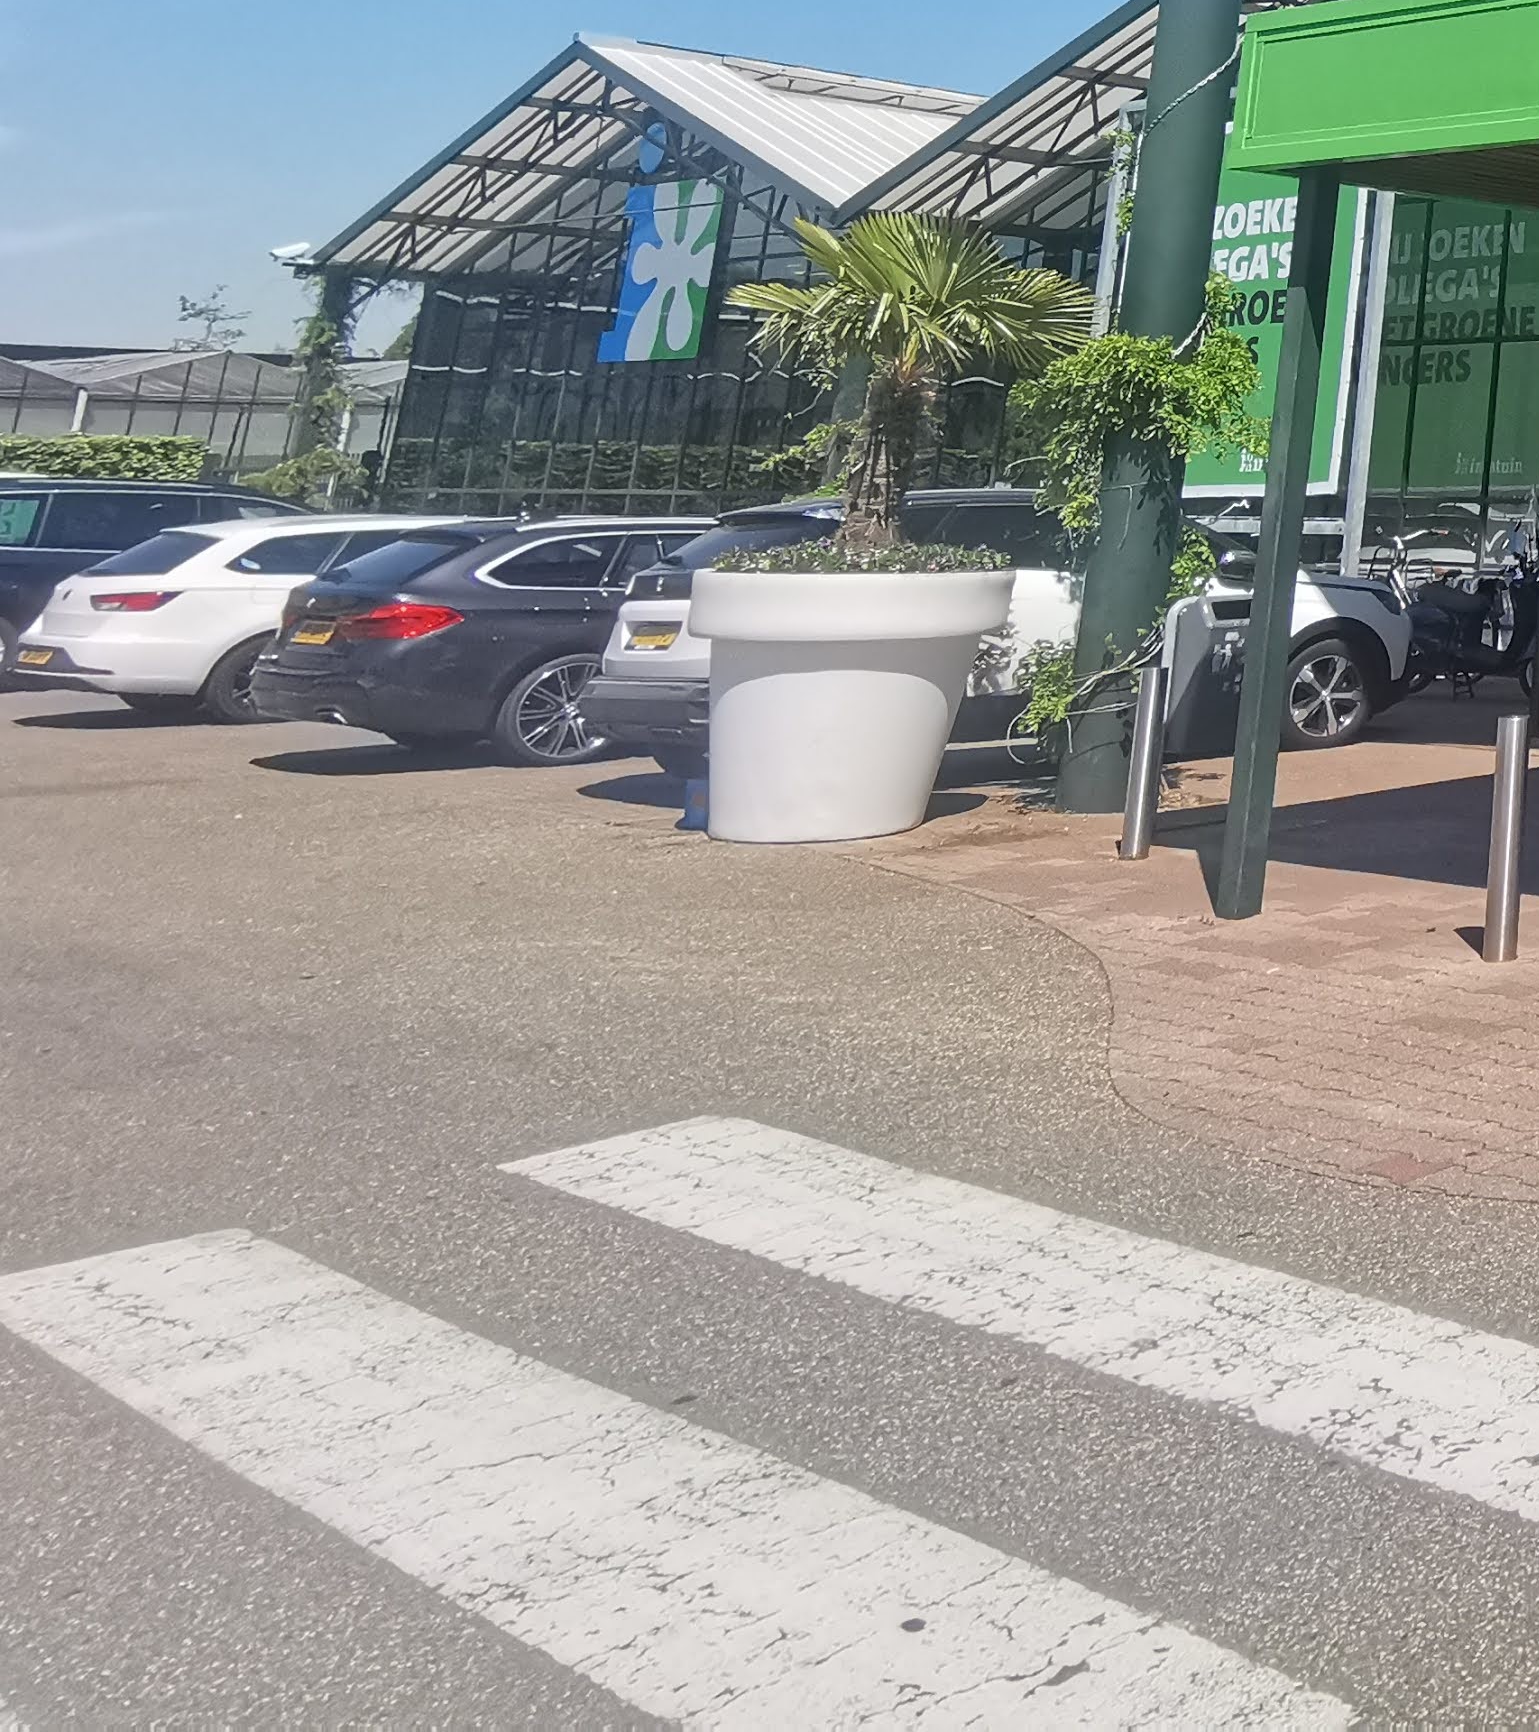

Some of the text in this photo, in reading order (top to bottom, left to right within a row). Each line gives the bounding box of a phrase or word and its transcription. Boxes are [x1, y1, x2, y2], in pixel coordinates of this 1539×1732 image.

[1213, 196, 1298, 240] ZOEKE
[1421, 221, 1526, 262] OEKEN
[1213, 242, 1293, 283] EGA'S
[1228, 290, 1287, 327] ROE
[1378, 348, 1472, 385] NGERS
